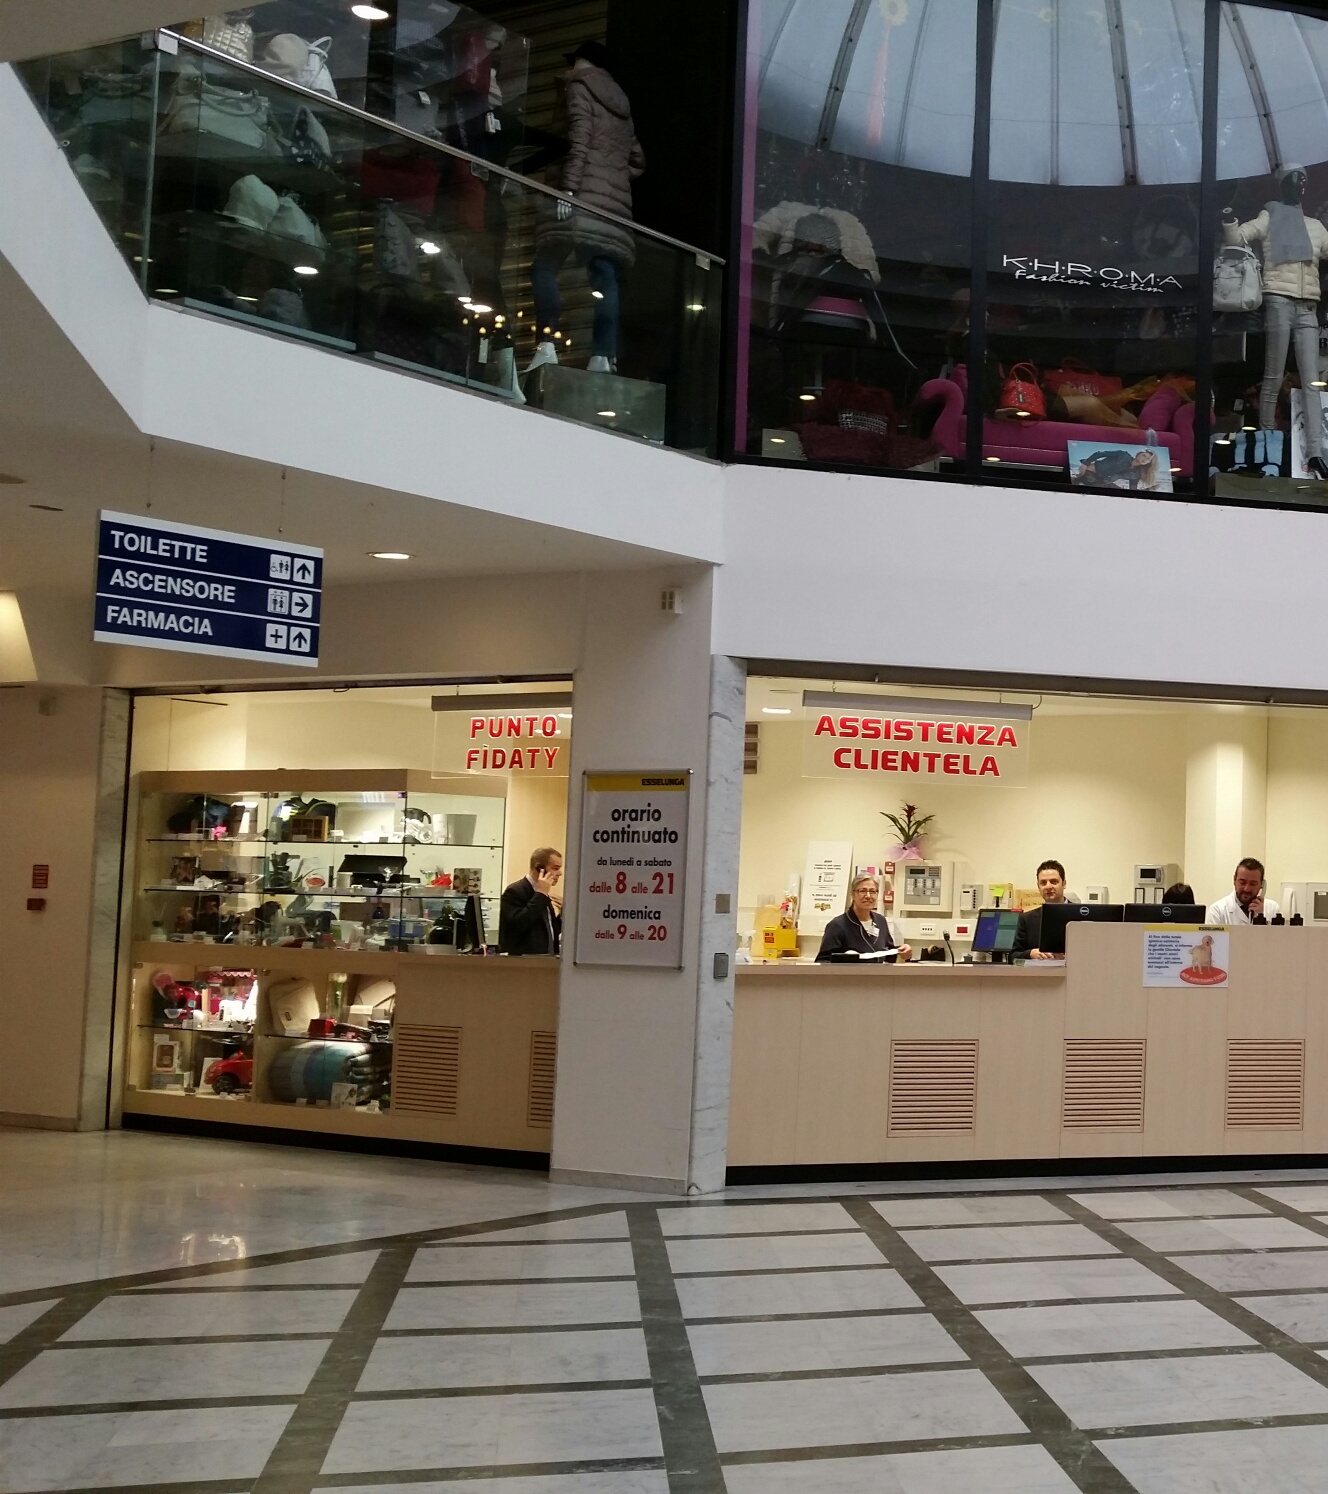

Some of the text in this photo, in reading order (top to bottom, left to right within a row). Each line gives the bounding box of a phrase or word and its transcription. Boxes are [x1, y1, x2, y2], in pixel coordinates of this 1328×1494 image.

[1015, 269, 1164, 292] Fashion victim
[110, 530, 208, 563] TOILETTE
[109, 568, 236, 603] ASCENSORE
[106, 605, 213, 636] FARMACIA
[470, 714, 557, 739] PUNTO
[814, 714, 1018, 747] ASSISTENZA
[833, 747, 1001, 777] CLIENTELA
[641, 778, 684, 786] ESSELUNGA
[611, 802, 661, 822] orario
[593, 824, 678, 843] continuato
[597, 857, 607, 867] da
[644, 857, 672, 867] sabato
[589, 871, 674, 894] dalle 8 alle 21
[603, 904, 661, 920] domenica
[595, 924, 667, 941] dalle 9 alle 20
